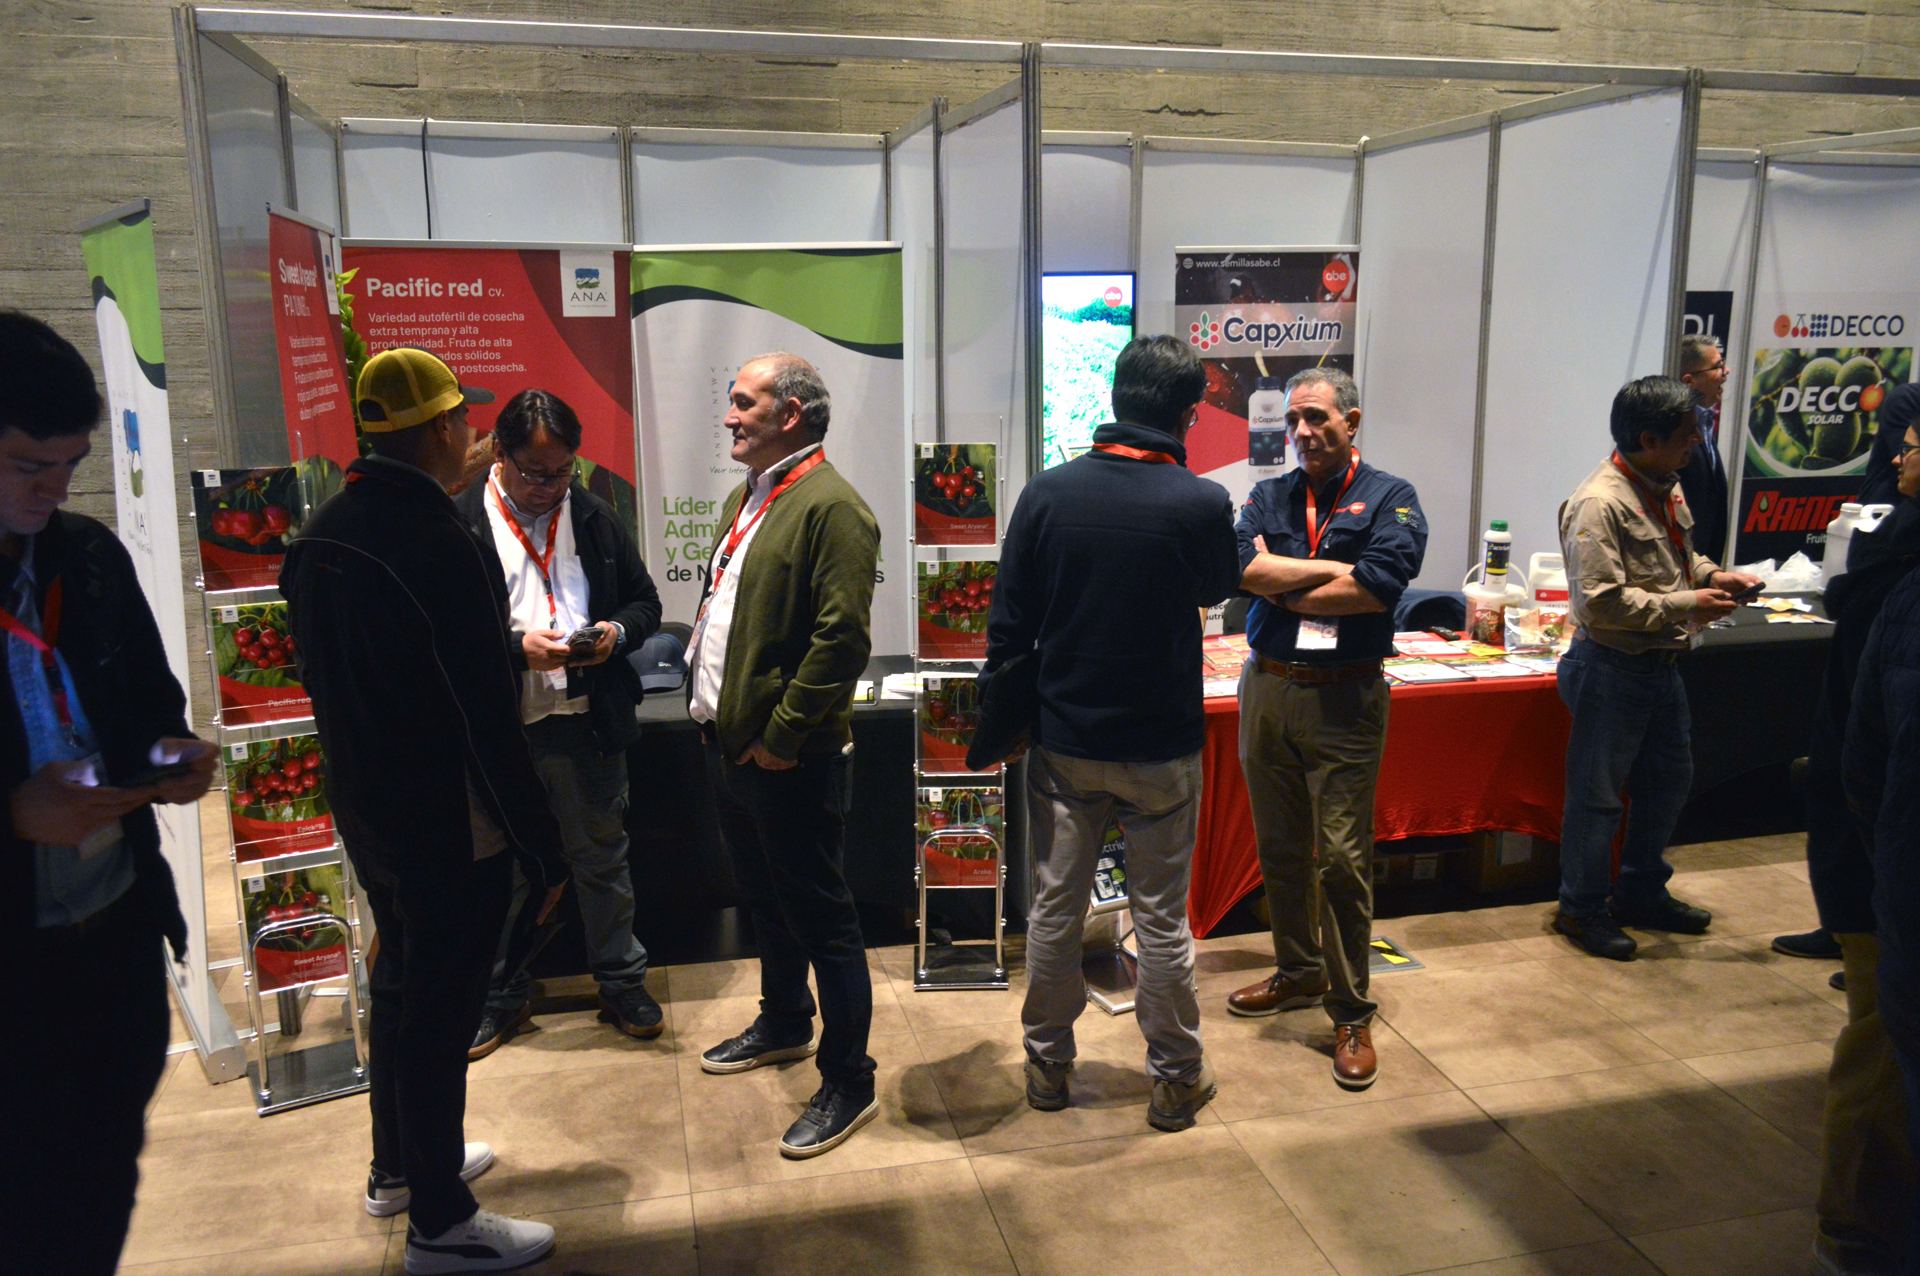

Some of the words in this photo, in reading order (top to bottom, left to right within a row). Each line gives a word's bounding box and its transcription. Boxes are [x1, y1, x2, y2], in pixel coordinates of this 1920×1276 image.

[1196, 257, 1280, 268] www.semillasabe.cl
[366, 278, 443, 297] Pacific
[448, 278, 483, 297] red
[488, 288, 505, 297] cv.
[570, 291, 606, 302] ANA
[368, 313, 416, 323] Variedad
[418, 312, 465, 322] autofértil
[467, 312, 480, 322] de
[482, 312, 525, 322] cosecha
[369, 327, 398, 336] extra
[400, 327, 450, 337] temprana
[451, 328, 457, 336] y
[459, 325, 479, 335] alta
[1830, 315, 1904, 337] DECCO
[1223, 316, 1341, 349] Capxium
[448, 337, 477, 348] Fruta
[478, 337, 491, 347] de
[493, 337, 513, 347] alta
[464, 350, 501, 360] sólidos
[459, 363, 527, 375] postcosecha.
[1807, 414, 1845, 425] SOLAR
[663, 496, 716, 516] Líder
[664, 519, 718, 538] Admi
[1807, 533, 1828, 544] Fruit
[665, 547, 677, 565] y
[683, 541, 712, 561] Ge
[667, 565, 692, 582] de
